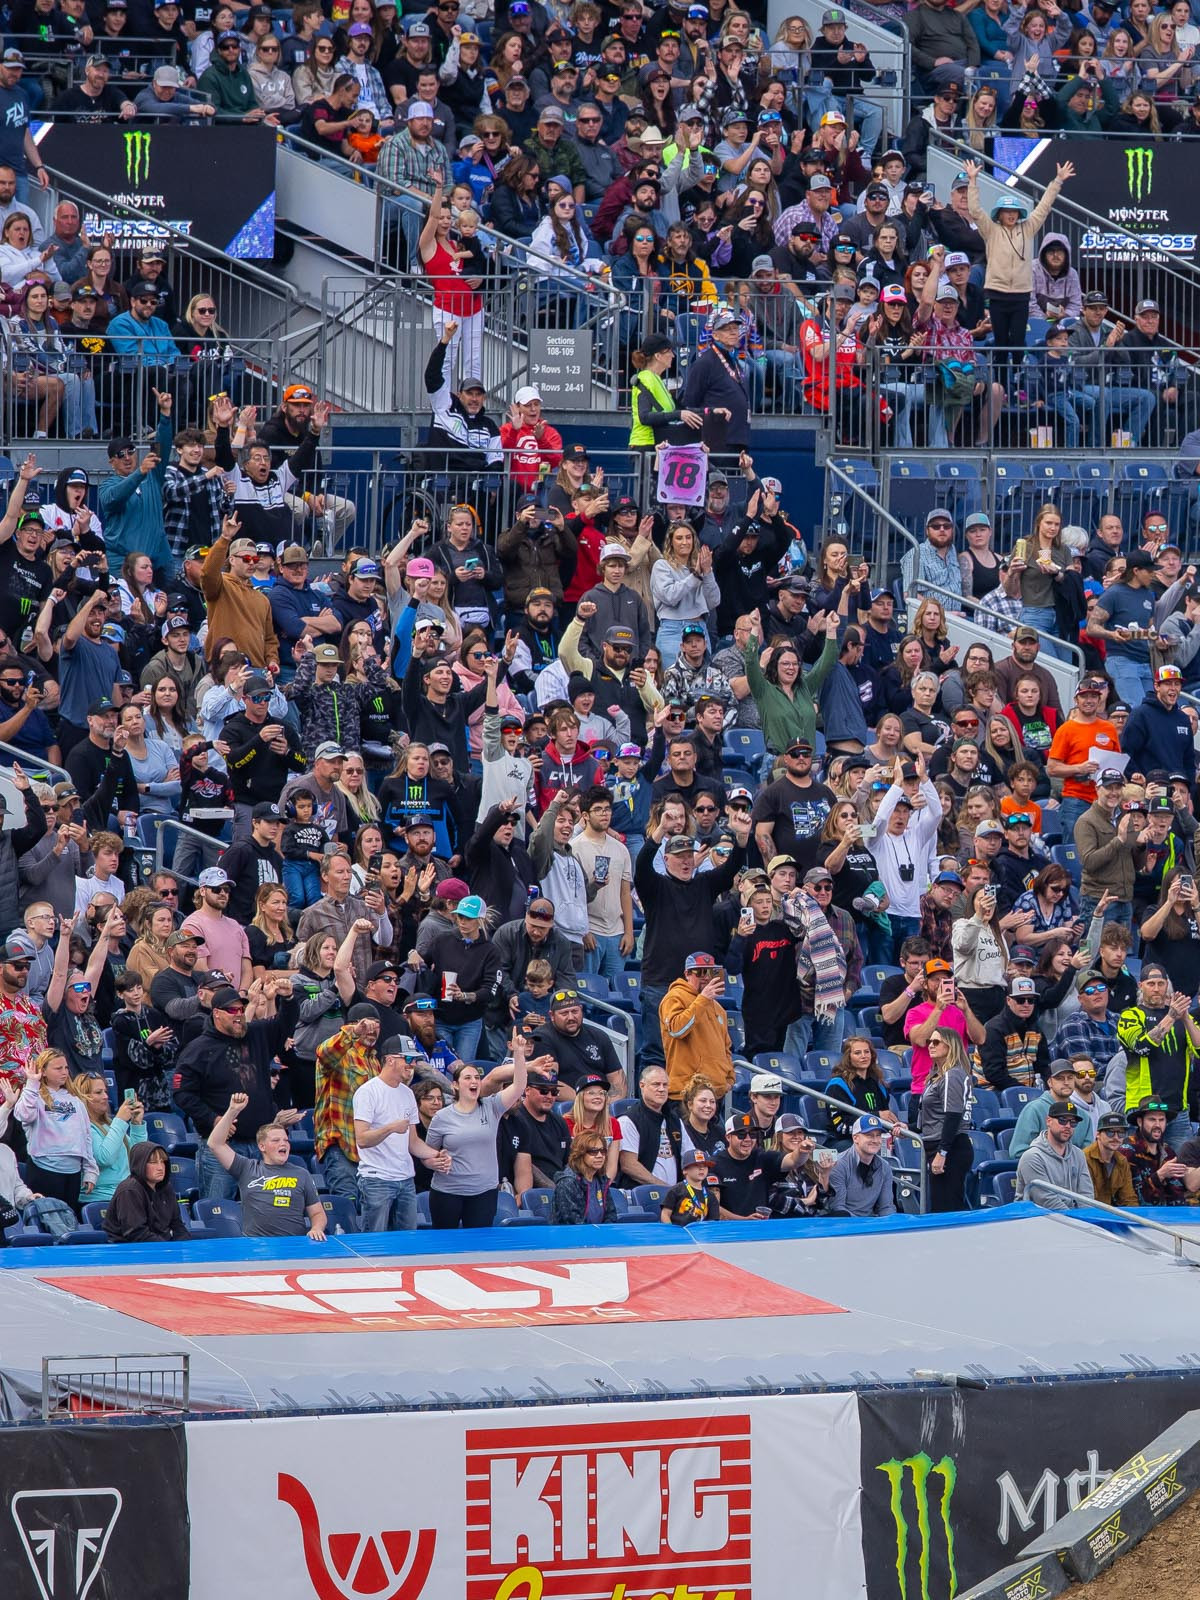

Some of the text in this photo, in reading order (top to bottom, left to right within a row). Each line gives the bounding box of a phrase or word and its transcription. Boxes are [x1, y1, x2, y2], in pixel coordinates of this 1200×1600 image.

[5, 102, 25, 126] FLY
[1108, 207, 1169, 221] MONSTER
[546, 336, 575, 345] Sections
[546, 348, 575, 356] 108-109
[541, 365, 581, 374] Rows 1-23
[541, 383, 585, 392] Rows 24-41
[664, 461, 700, 489] 18
[1067, 1102, 1074, 1111] P
[136, 1261, 631, 1315] FLY
[1080, 1476, 1121, 1511] SUPER
[1145, 1481, 1166, 1500] SUPER
[1149, 1487, 1167, 1505] MOTO
[490, 1447, 730, 1565] KING
[1150, 1493, 1169, 1511] CROSS
[1089, 1529, 1109, 1548] SUPER
[1092, 1535, 1110, 1553] MOTO
[1093, 1541, 1113, 1560] CROSS
[1007, 1583, 1028, 1600] SUPER
